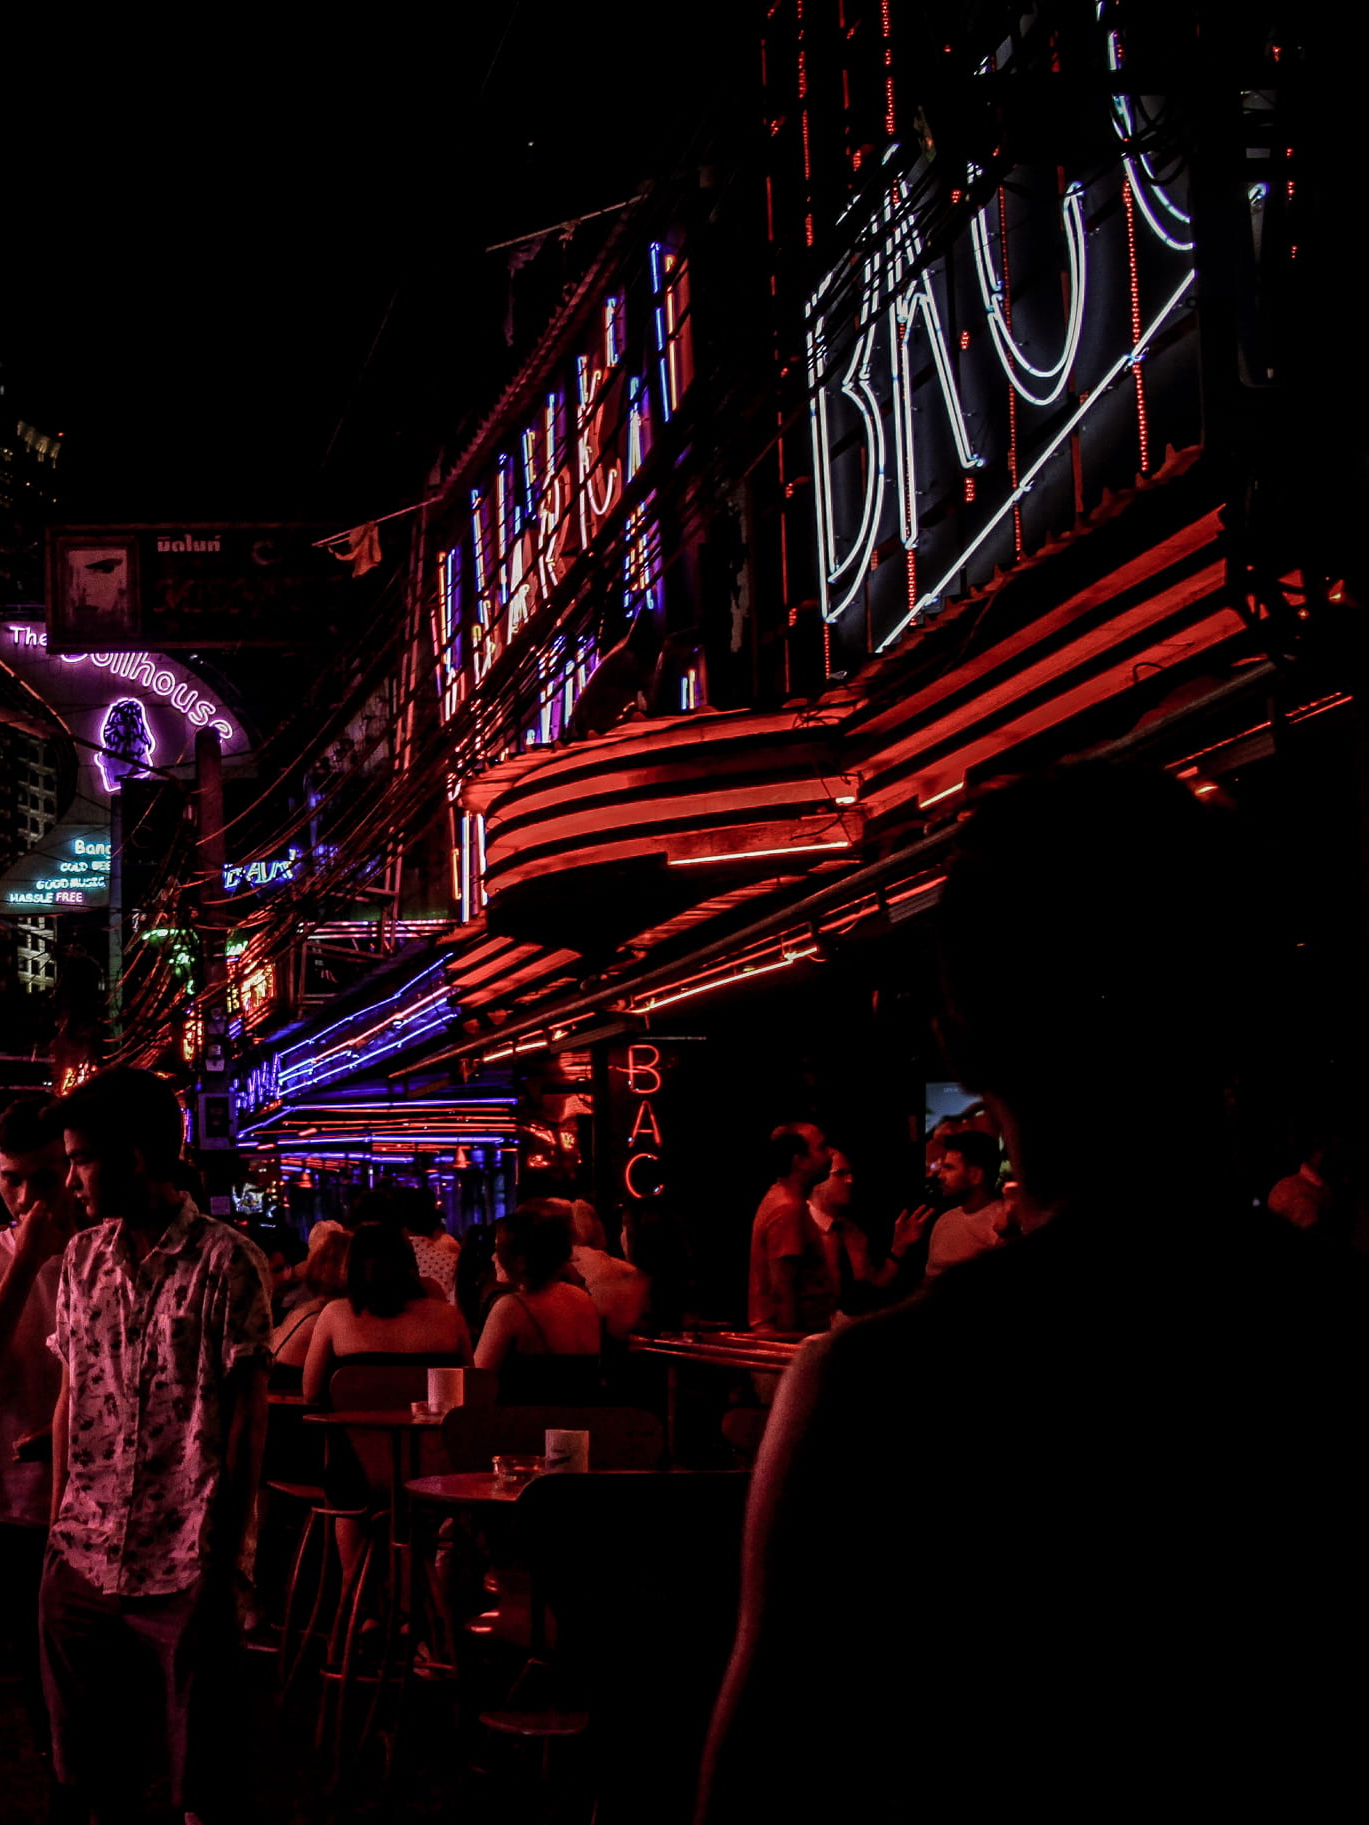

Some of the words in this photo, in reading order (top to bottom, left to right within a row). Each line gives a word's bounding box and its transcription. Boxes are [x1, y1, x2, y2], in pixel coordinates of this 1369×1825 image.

[9, 625, 48, 648] The
[61, 652, 234, 744] ollhouse
[55, 891, 84, 903] FREE
